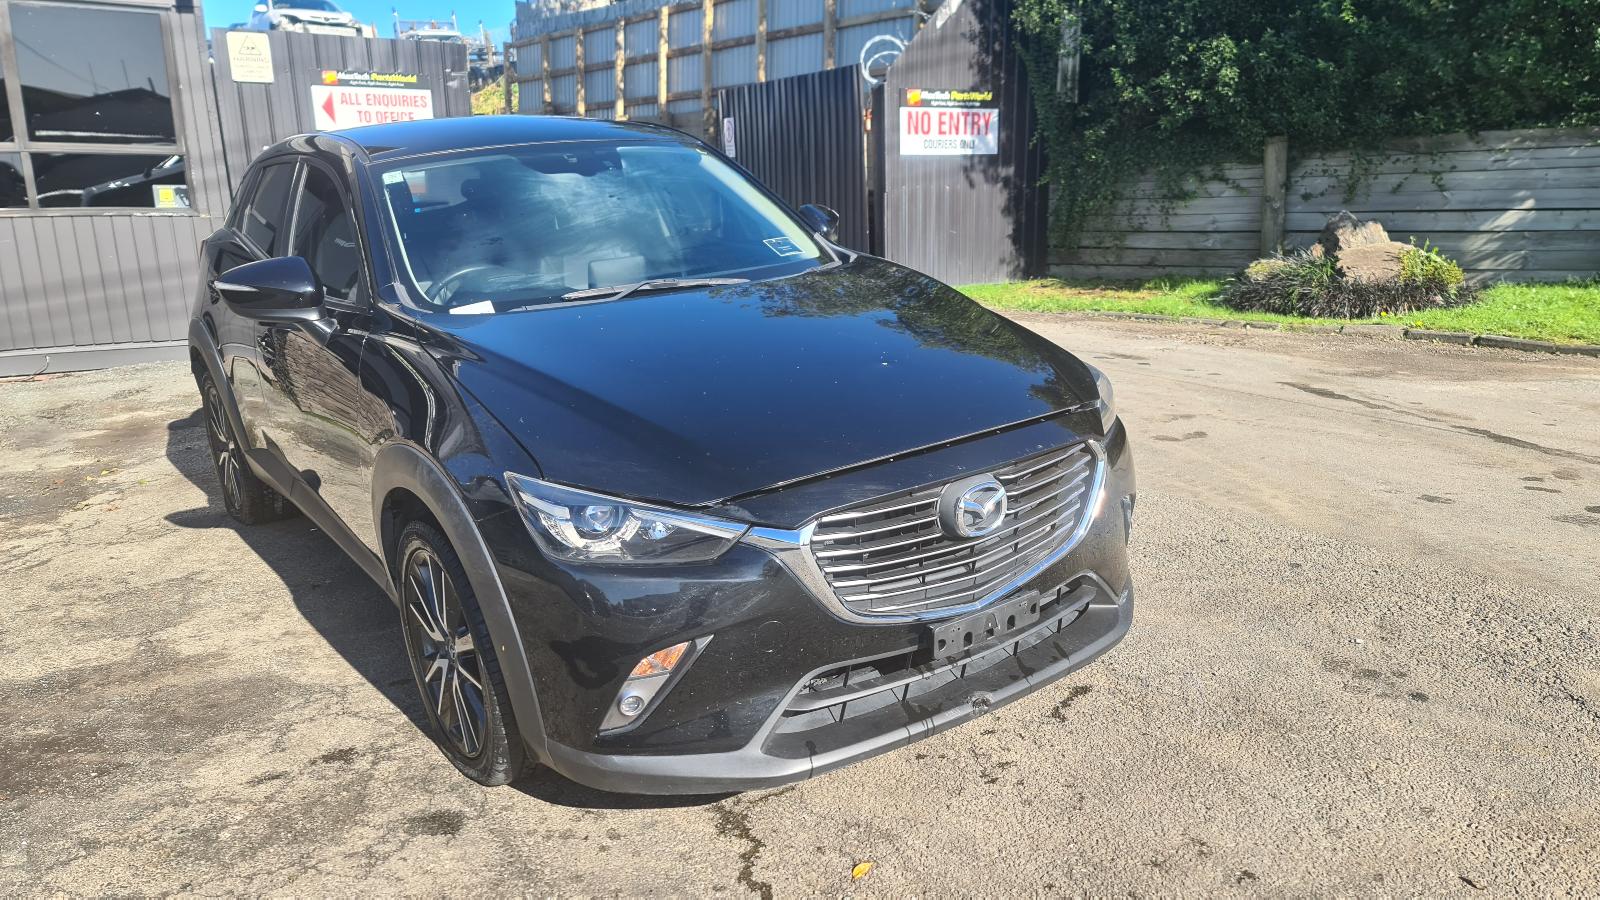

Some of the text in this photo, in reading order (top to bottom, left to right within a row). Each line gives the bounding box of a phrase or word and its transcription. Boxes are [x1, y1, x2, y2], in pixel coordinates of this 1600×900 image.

[340, 92, 428, 108] ALL ENQUIRIES
[357, 110, 372, 123] TO
[907, 111, 993, 136] NO ENTRY
[923, 139, 958, 150] COURIERS
